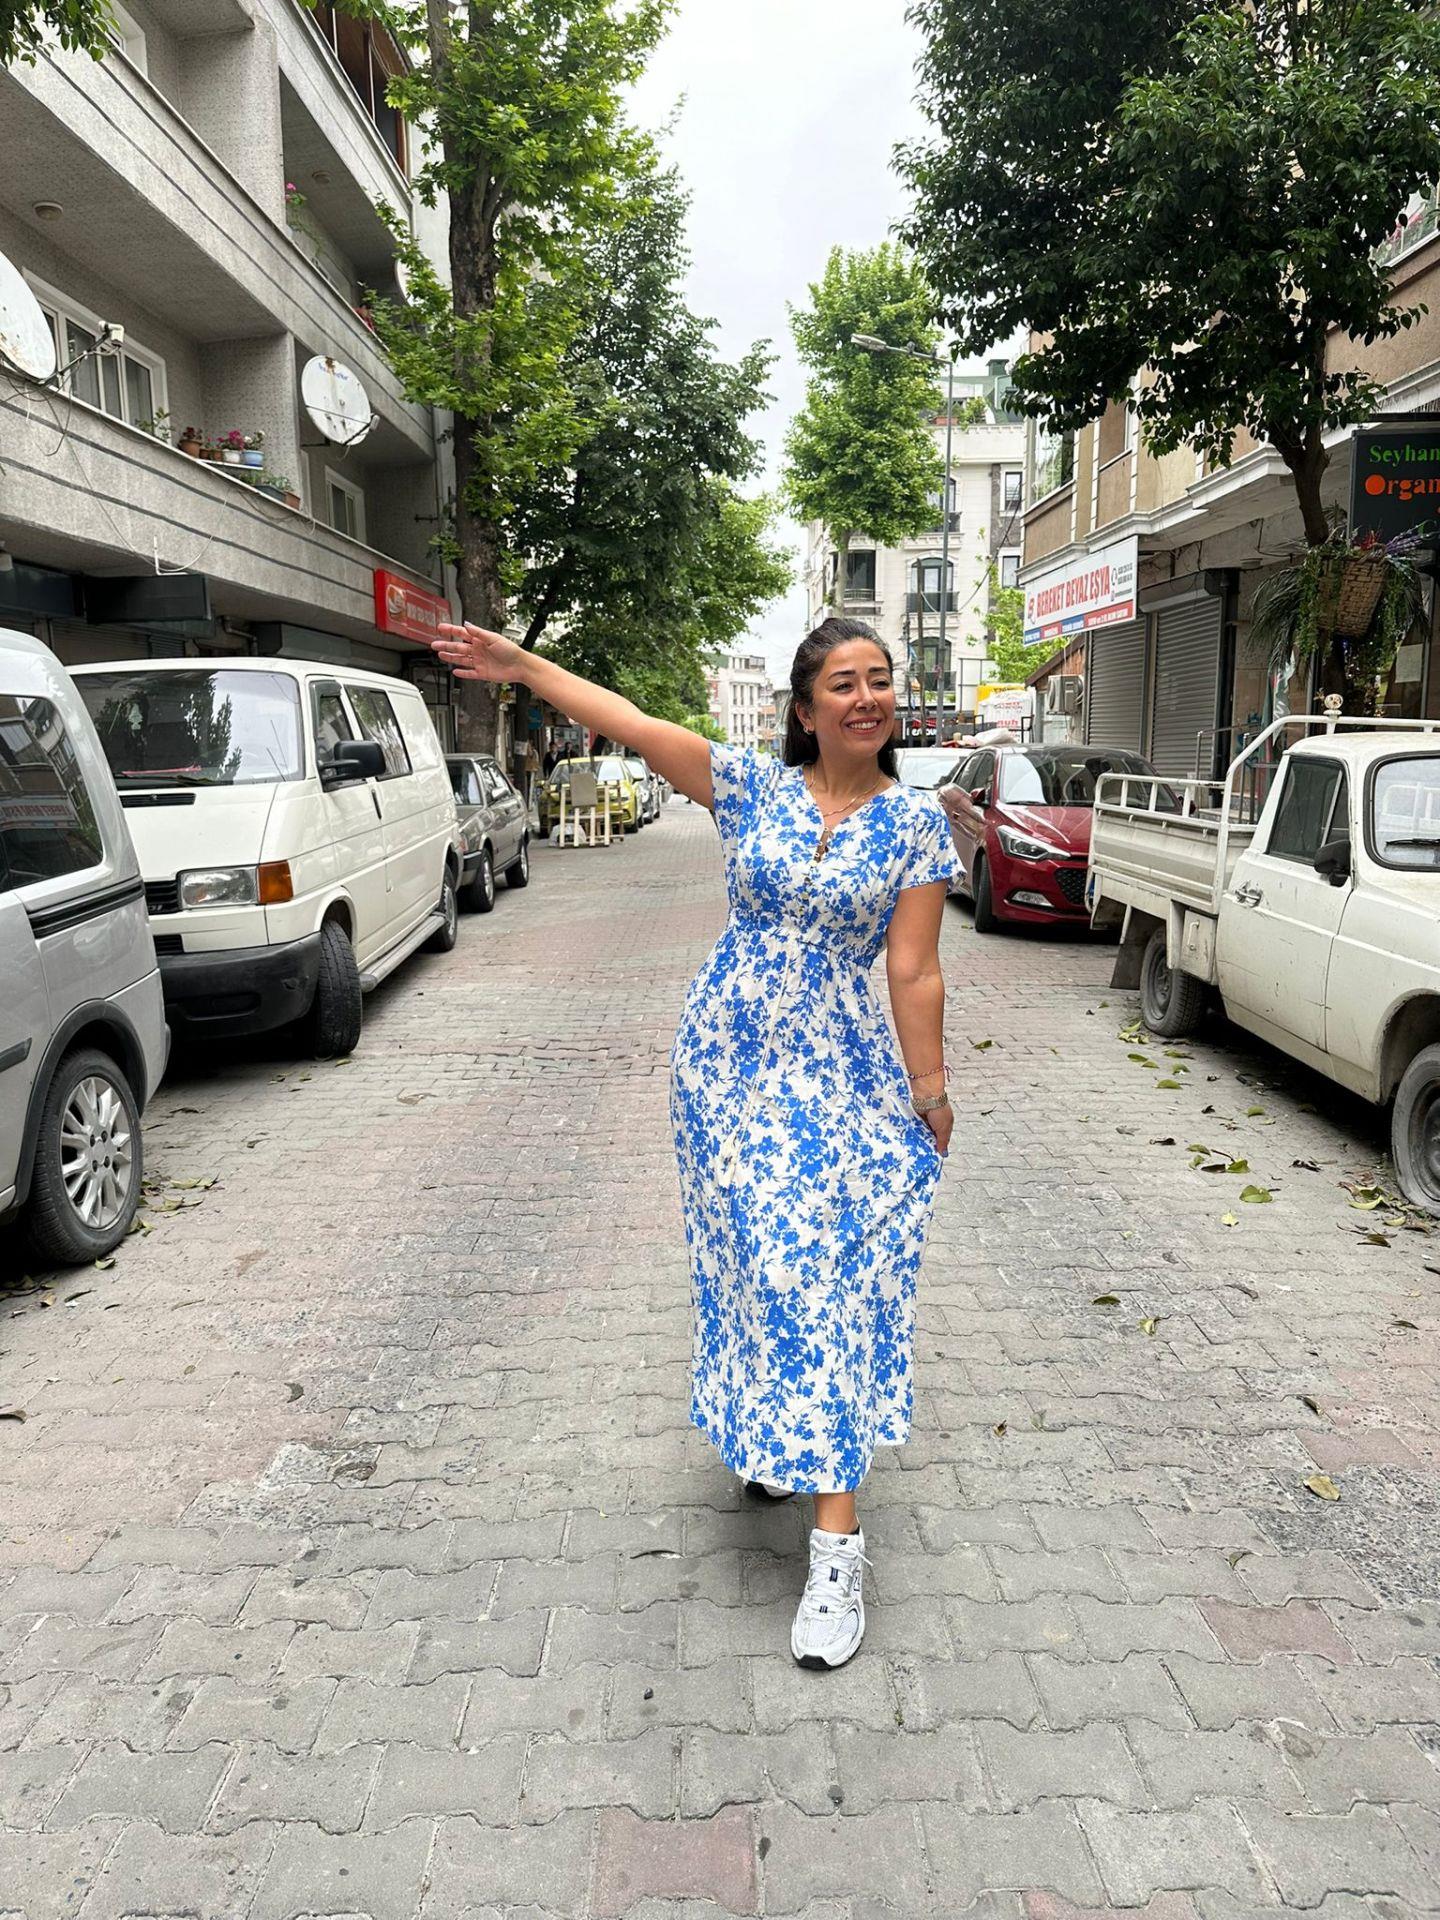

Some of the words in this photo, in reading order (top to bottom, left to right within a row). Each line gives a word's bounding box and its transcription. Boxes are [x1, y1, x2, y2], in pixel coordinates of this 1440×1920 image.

[1036, 583, 1065, 618] BEREKET
[1065, 573, 1089, 608] BEYAZ
[1089, 565, 1110, 604] EŞYA
